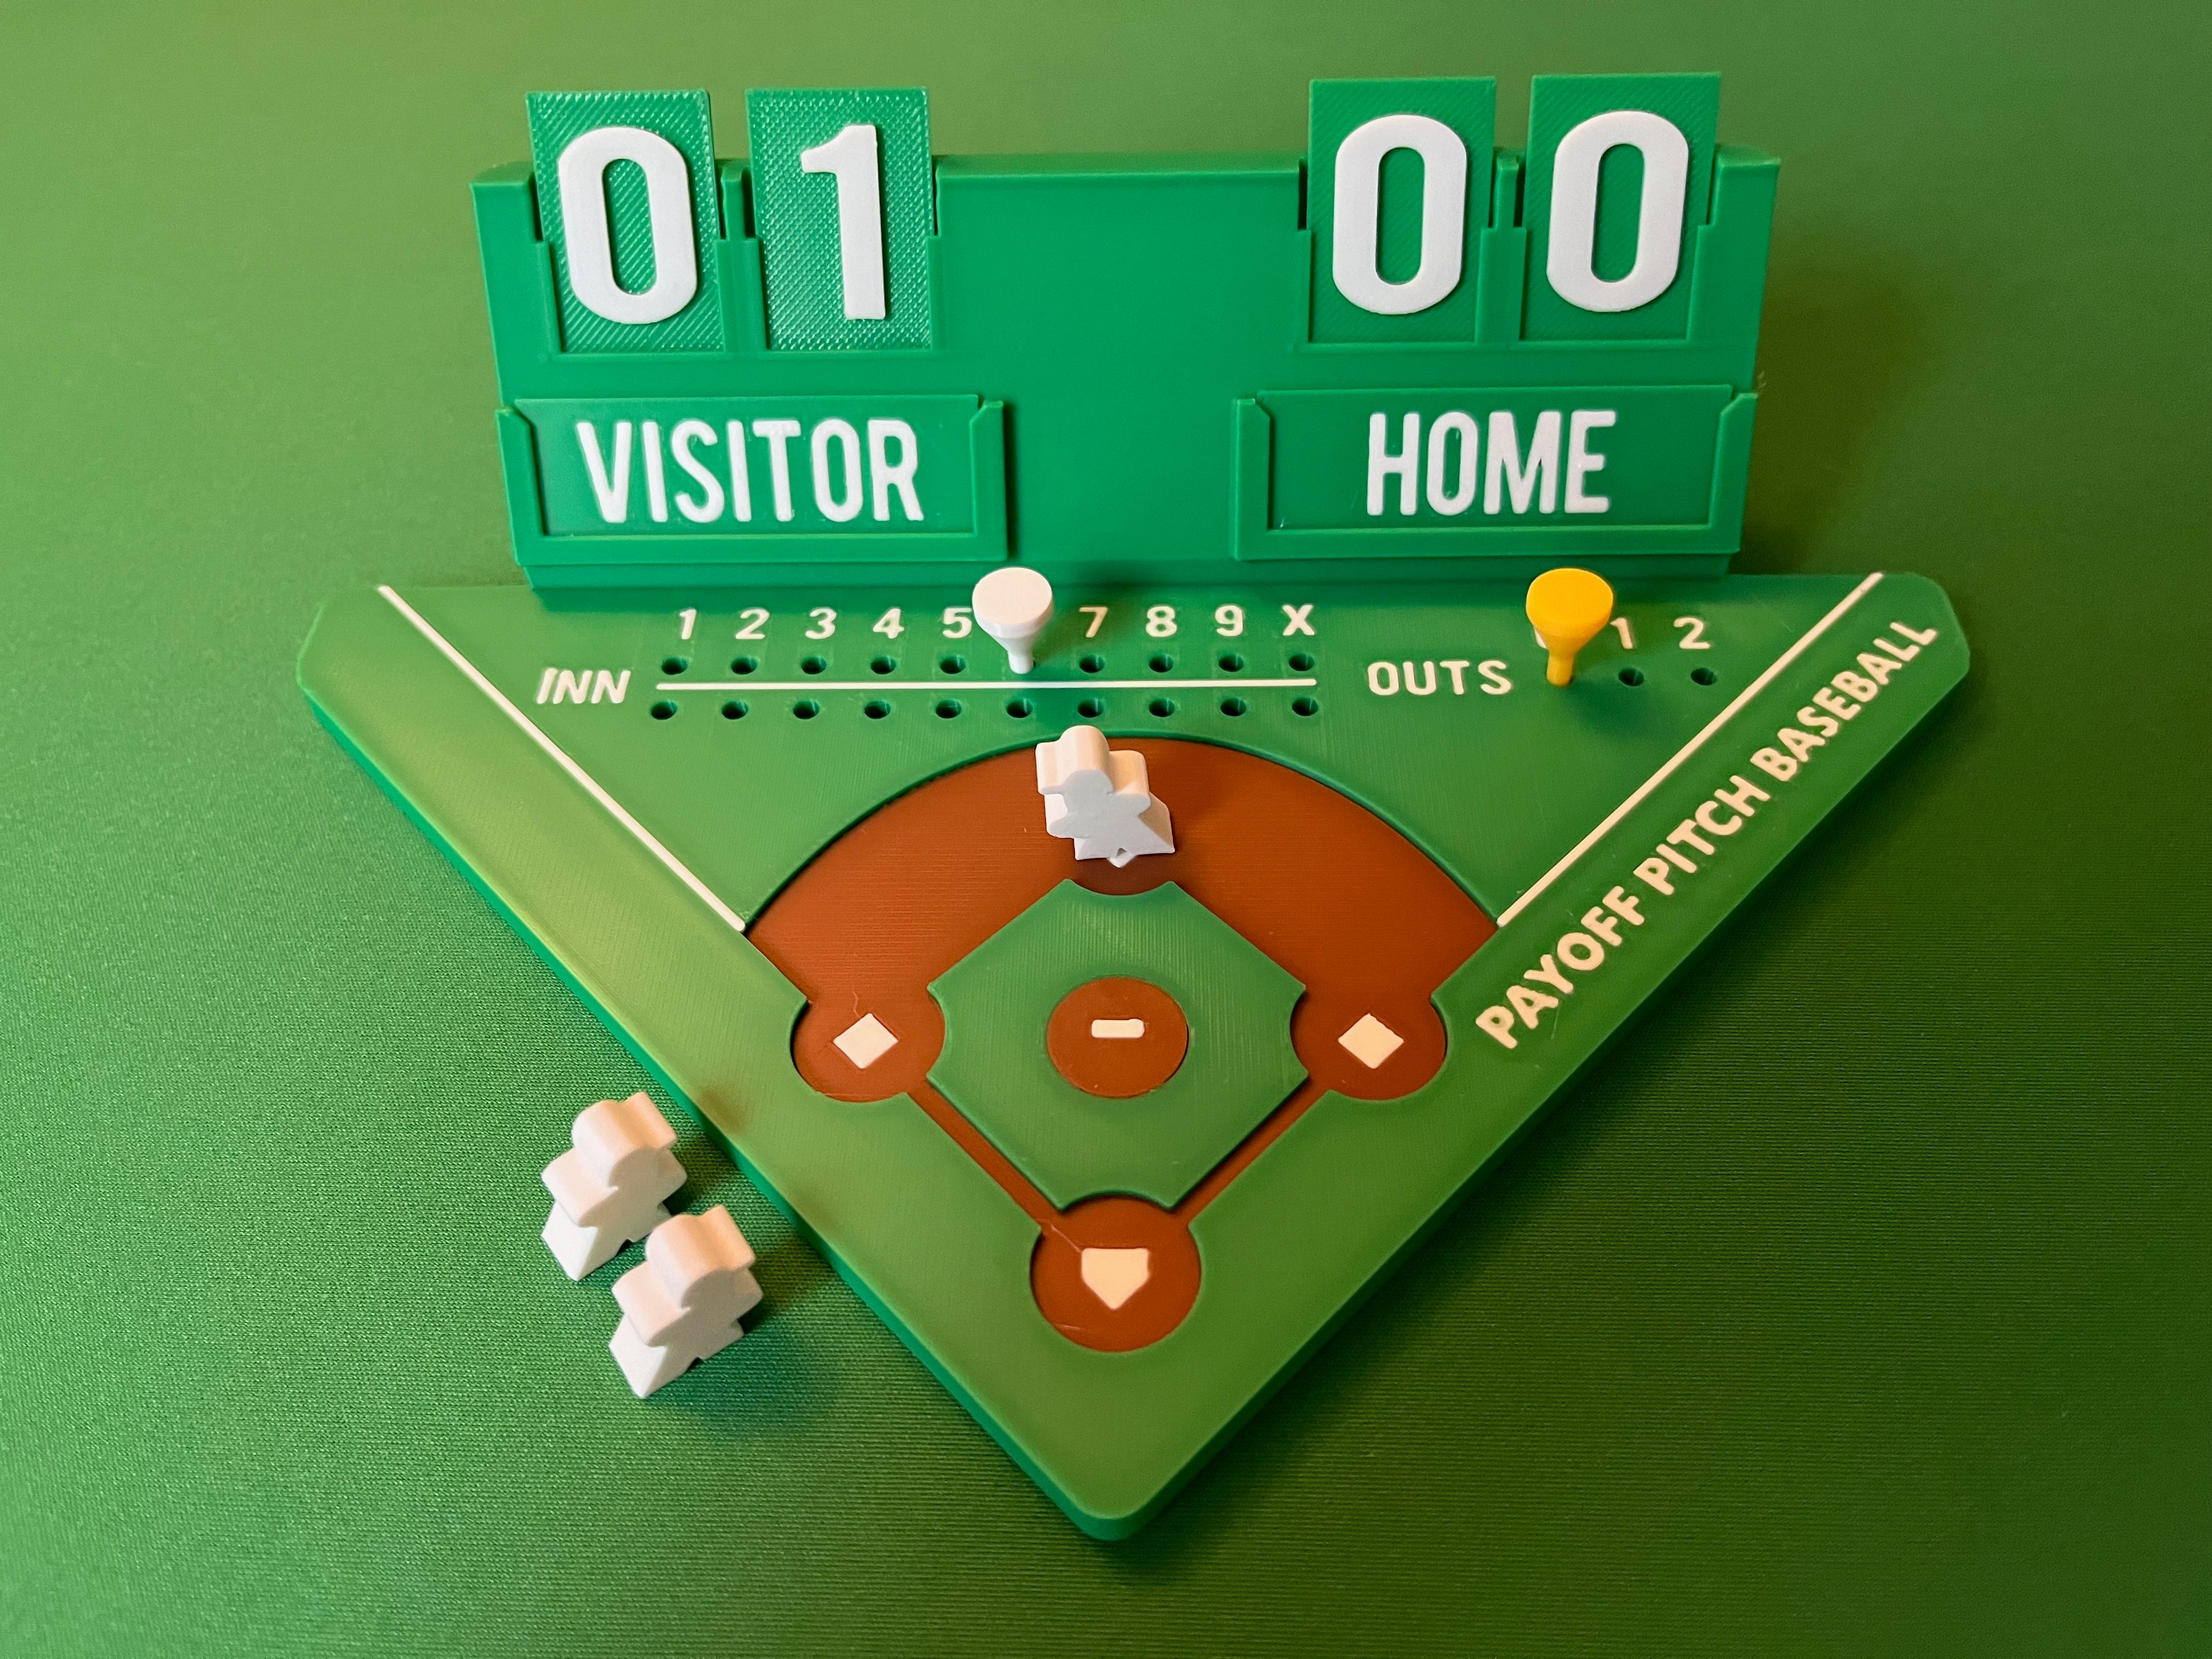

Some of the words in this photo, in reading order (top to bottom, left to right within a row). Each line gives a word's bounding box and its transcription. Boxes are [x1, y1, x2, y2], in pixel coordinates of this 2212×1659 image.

[576, 417, 924, 524] VISITOR
[1366, 408, 1618, 516] HOME
[678, 607, 698, 641] 1
[734, 607, 771, 641] 2
[804, 607, 838, 641] 3
[872, 607, 906, 640] 4
[941, 606, 973, 639] 5
[1078, 606, 1108, 638] 7
[1145, 604, 1178, 638] 8
[1214, 604, 1246, 638] 9
[1282, 603, 1317, 637] X
[1610, 616, 1634, 650] 1
[1673, 616, 1712, 650] 2
[533, 666, 632, 706] INN
[1366, 659, 1514, 696] OUTS
[1475, 885, 1646, 1049] PAYOFF
[1633, 775, 1771, 896] PITCH
[1749, 621, 1938, 782] BASEBALL
